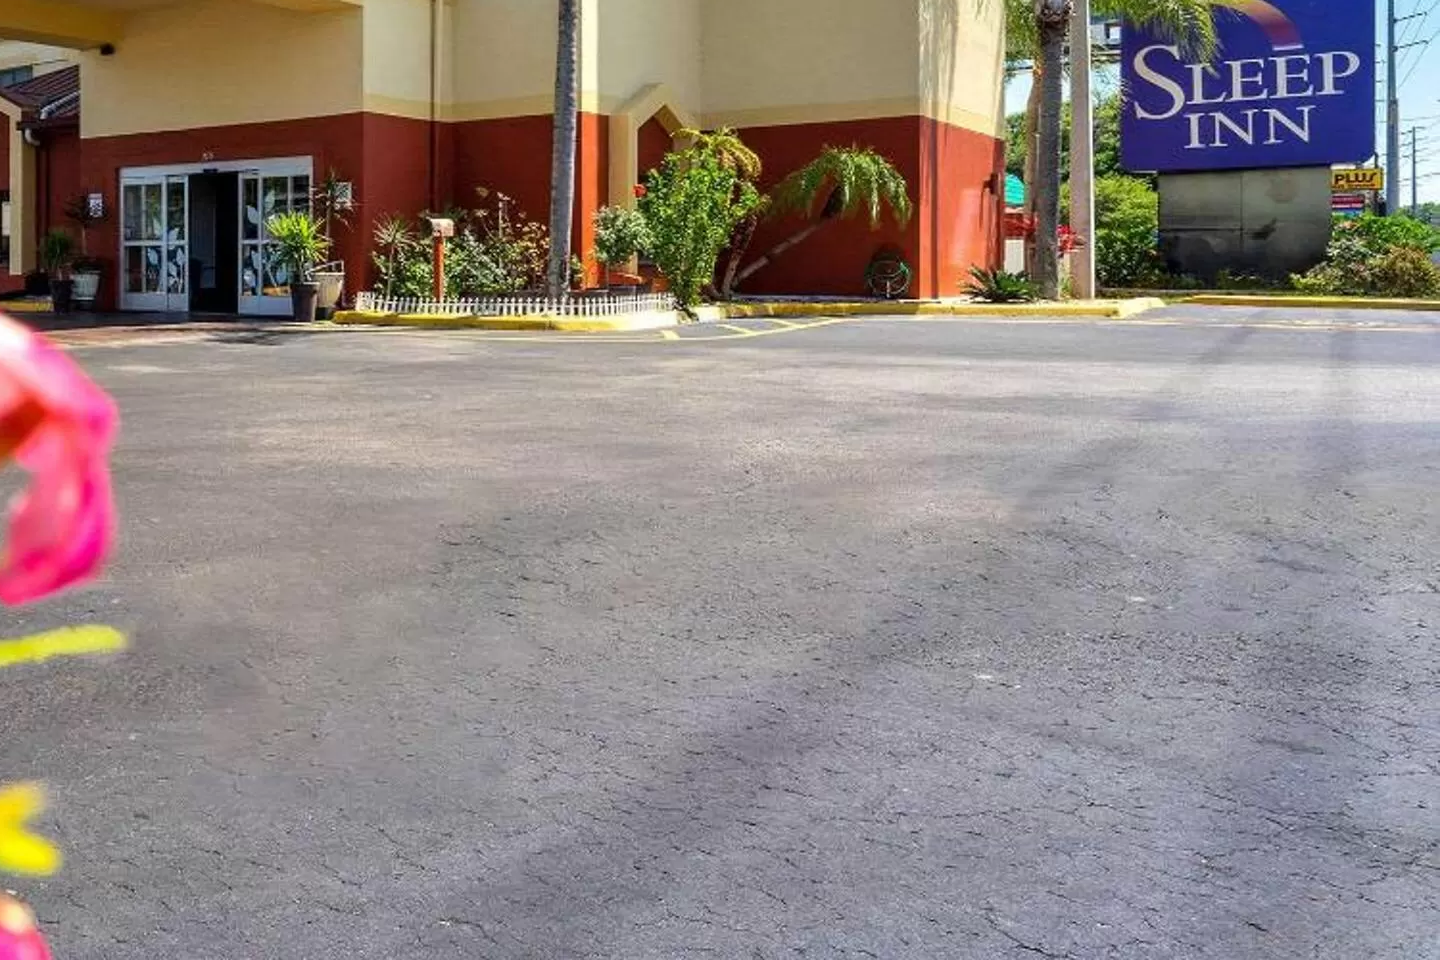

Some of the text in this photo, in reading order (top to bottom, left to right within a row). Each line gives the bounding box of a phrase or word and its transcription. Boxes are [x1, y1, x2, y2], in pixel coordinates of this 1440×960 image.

[1132, 43, 1361, 121] SLEEP
[1184, 105, 1317, 150] INN
[1334, 172, 1378, 185] PLUS
